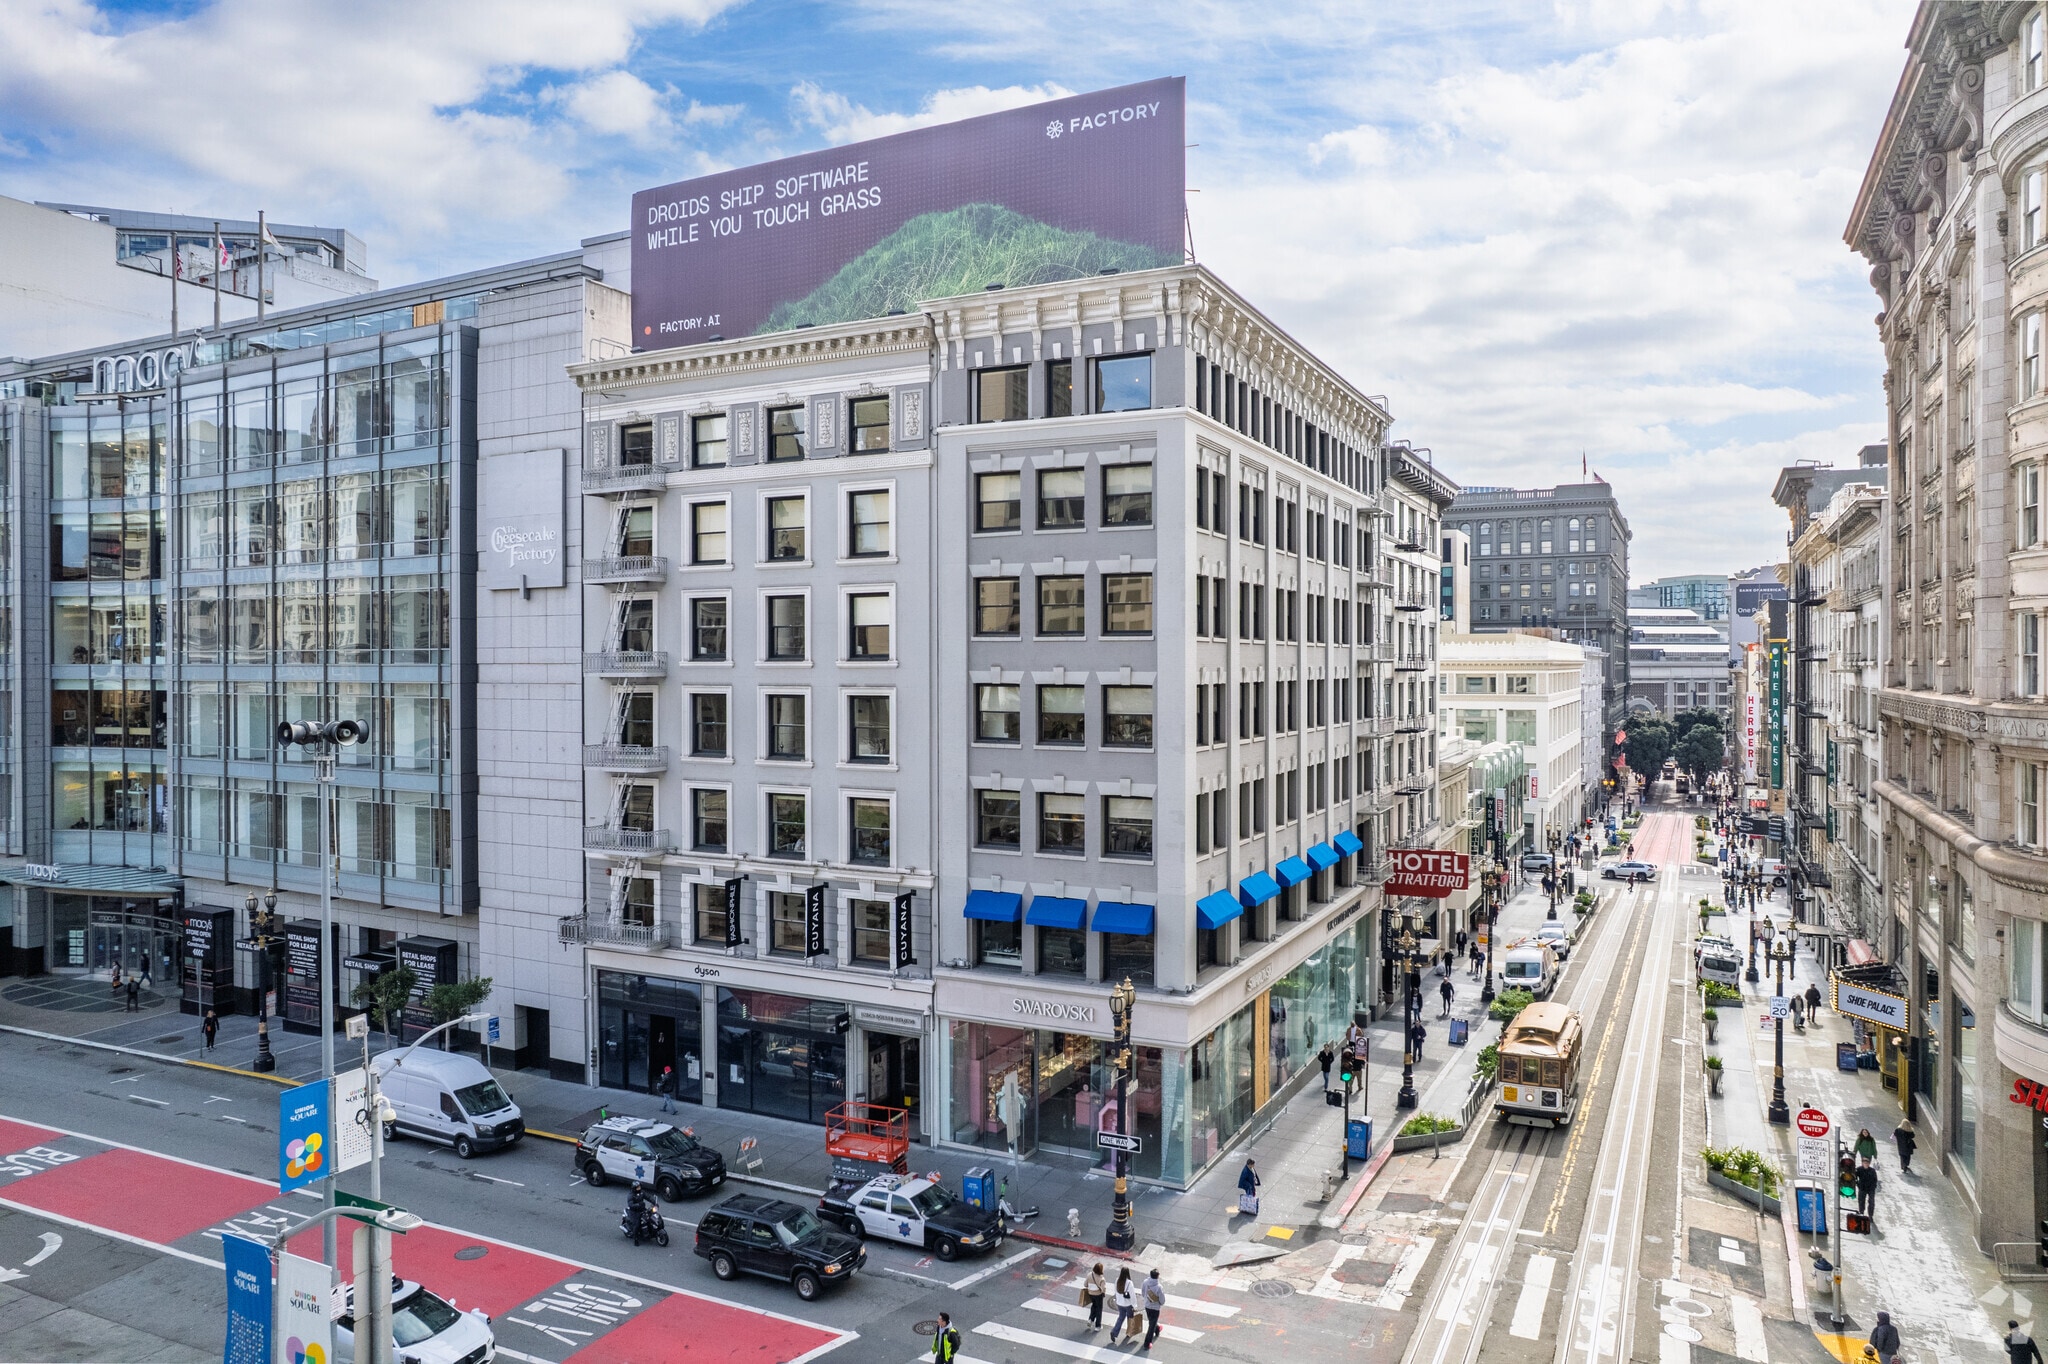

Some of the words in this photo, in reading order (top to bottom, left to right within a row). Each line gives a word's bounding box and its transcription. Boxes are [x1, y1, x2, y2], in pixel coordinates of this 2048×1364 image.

[1070, 101, 1160, 133] FACTORY
[648, 196, 710, 225] DROIDS
[720, 184, 764, 210] SHIP
[775, 161, 869, 199] SOFTWARE
[648, 222, 699, 250] WHILE
[710, 215, 742, 237] YOU
[753, 201, 809, 228] TOUCH
[821, 186, 881, 216] GRASS
[660, 315, 720, 333] FACTORY.AI
[491, 526, 556, 553] Cheesecake
[504, 543, 557, 569] Factory
[1389, 852, 1464, 874] HOTEL
[1387, 872, 1465, 888] STRATFORD
[189, 918, 213, 931] macy's
[287, 933, 302, 941] RETAIL
[303, 936, 318, 944] SHOPS
[300, 943, 317, 951] LEASE
[402, 951, 419, 960] RETAIL
[419, 954, 437, 962] SHOPS
[345, 960, 364, 969] RETAIL
[364, 963, 379, 971] SHOP
[416, 960, 435, 970] LEASE
[694, 964, 720, 977] dyson
[1012, 998, 1094, 1022] SWAROVSKI
[1772, 1007, 1787, 1016] 20
[1847, 994, 1866, 1007] SHOE
[1867, 999, 1897, 1016] PALACE
[289, 1108, 318, 1122] SQUARE
[294, 1104, 314, 1113] UNION
[1101, 1136, 1113, 1144] ONE
[1115, 1137, 1128, 1145] WAY
[1803, 1159, 1826, 1167] VEHICLES
[1803, 1164, 1825, 1172] LOADING
[1809, 1169, 1829, 1177] POWELL
[237, 1269, 256, 1283] UNION
[233, 1276, 260, 1295] SQUARE
[294, 1289, 317, 1303] UNION
[289, 1297, 321, 1315] SQUARE
[506, 1283, 643, 1347] ONLY
